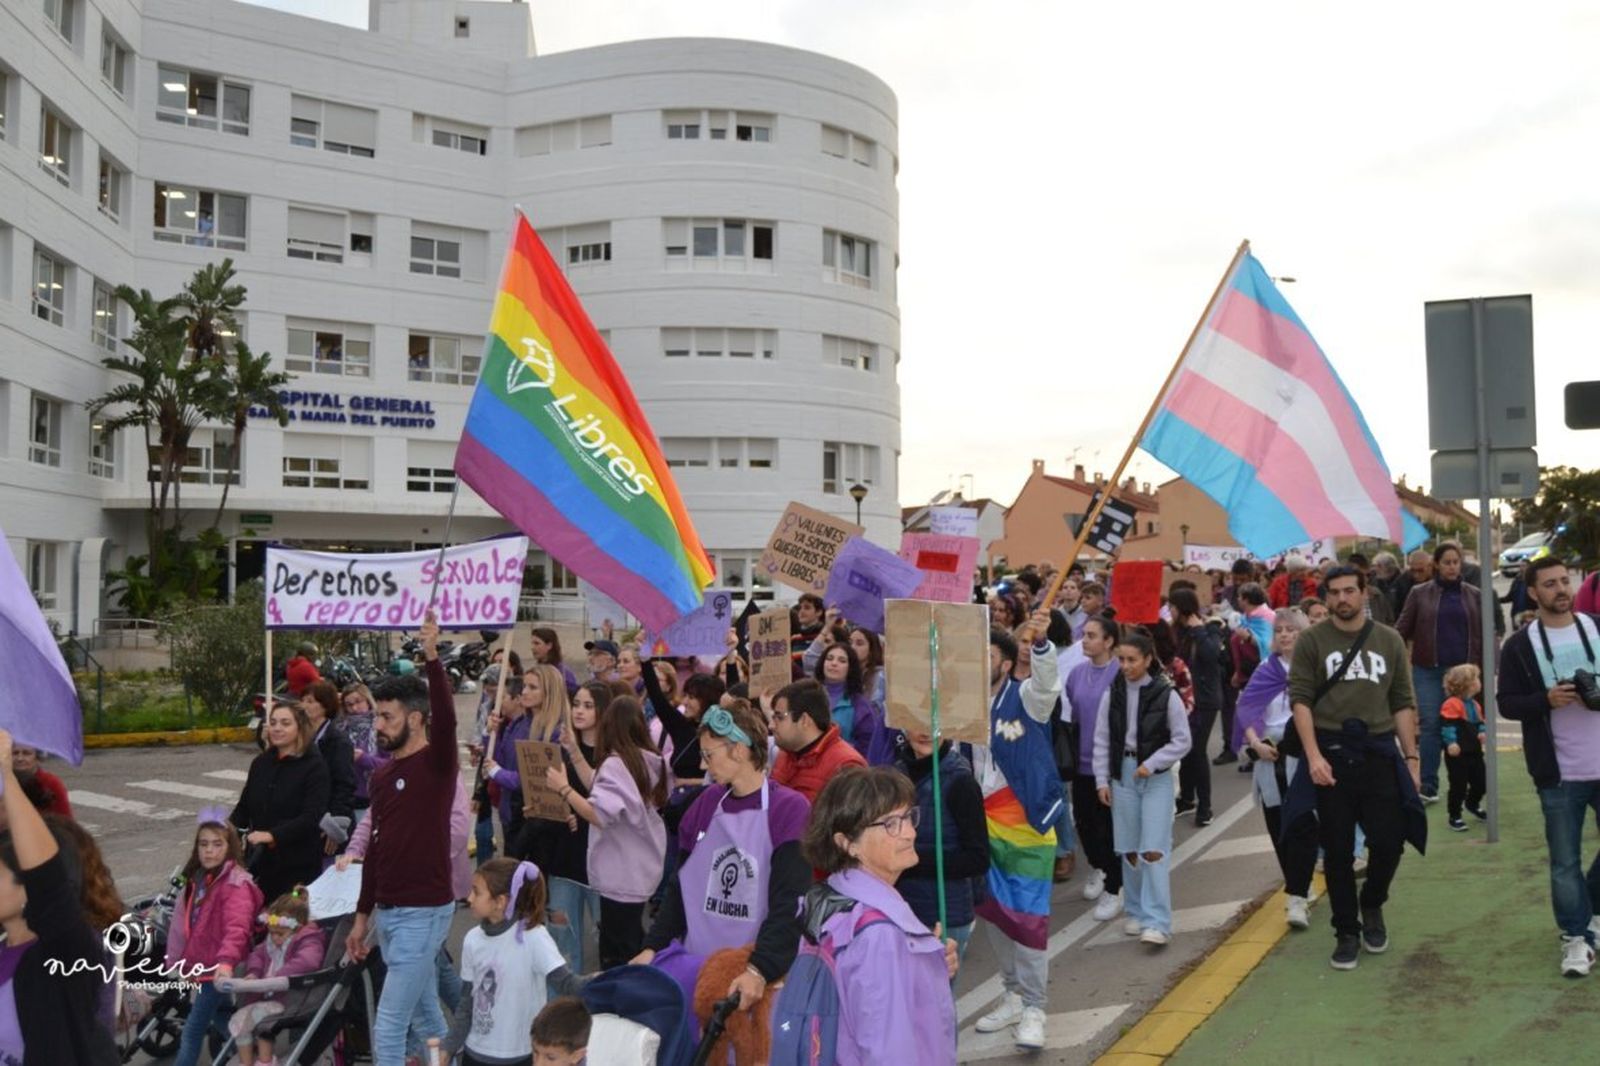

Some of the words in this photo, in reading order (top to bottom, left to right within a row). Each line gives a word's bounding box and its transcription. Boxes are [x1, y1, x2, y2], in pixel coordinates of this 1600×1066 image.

[272, 390, 344, 409] SPITAL
[350, 395, 435, 415] GENERAL
[248, 407, 296, 421] SANA
[301, 410, 346, 423] MARIA
[350, 415, 376, 426] DEL
[381, 417, 436, 429] PUERTO
[551, 393, 654, 496] Libres
[794, 532, 805, 543] YA
[799, 516, 846, 543] VALIENTES
[774, 539, 819, 565] QUEREMOS
[818, 556, 833, 571] SE
[272, 559, 398, 596] Derechos
[781, 560, 817, 583] LIBRES
[1325, 649, 1387, 684] GAP
[705, 896, 718, 911] EN
[718, 899, 749, 918] LUCHA
